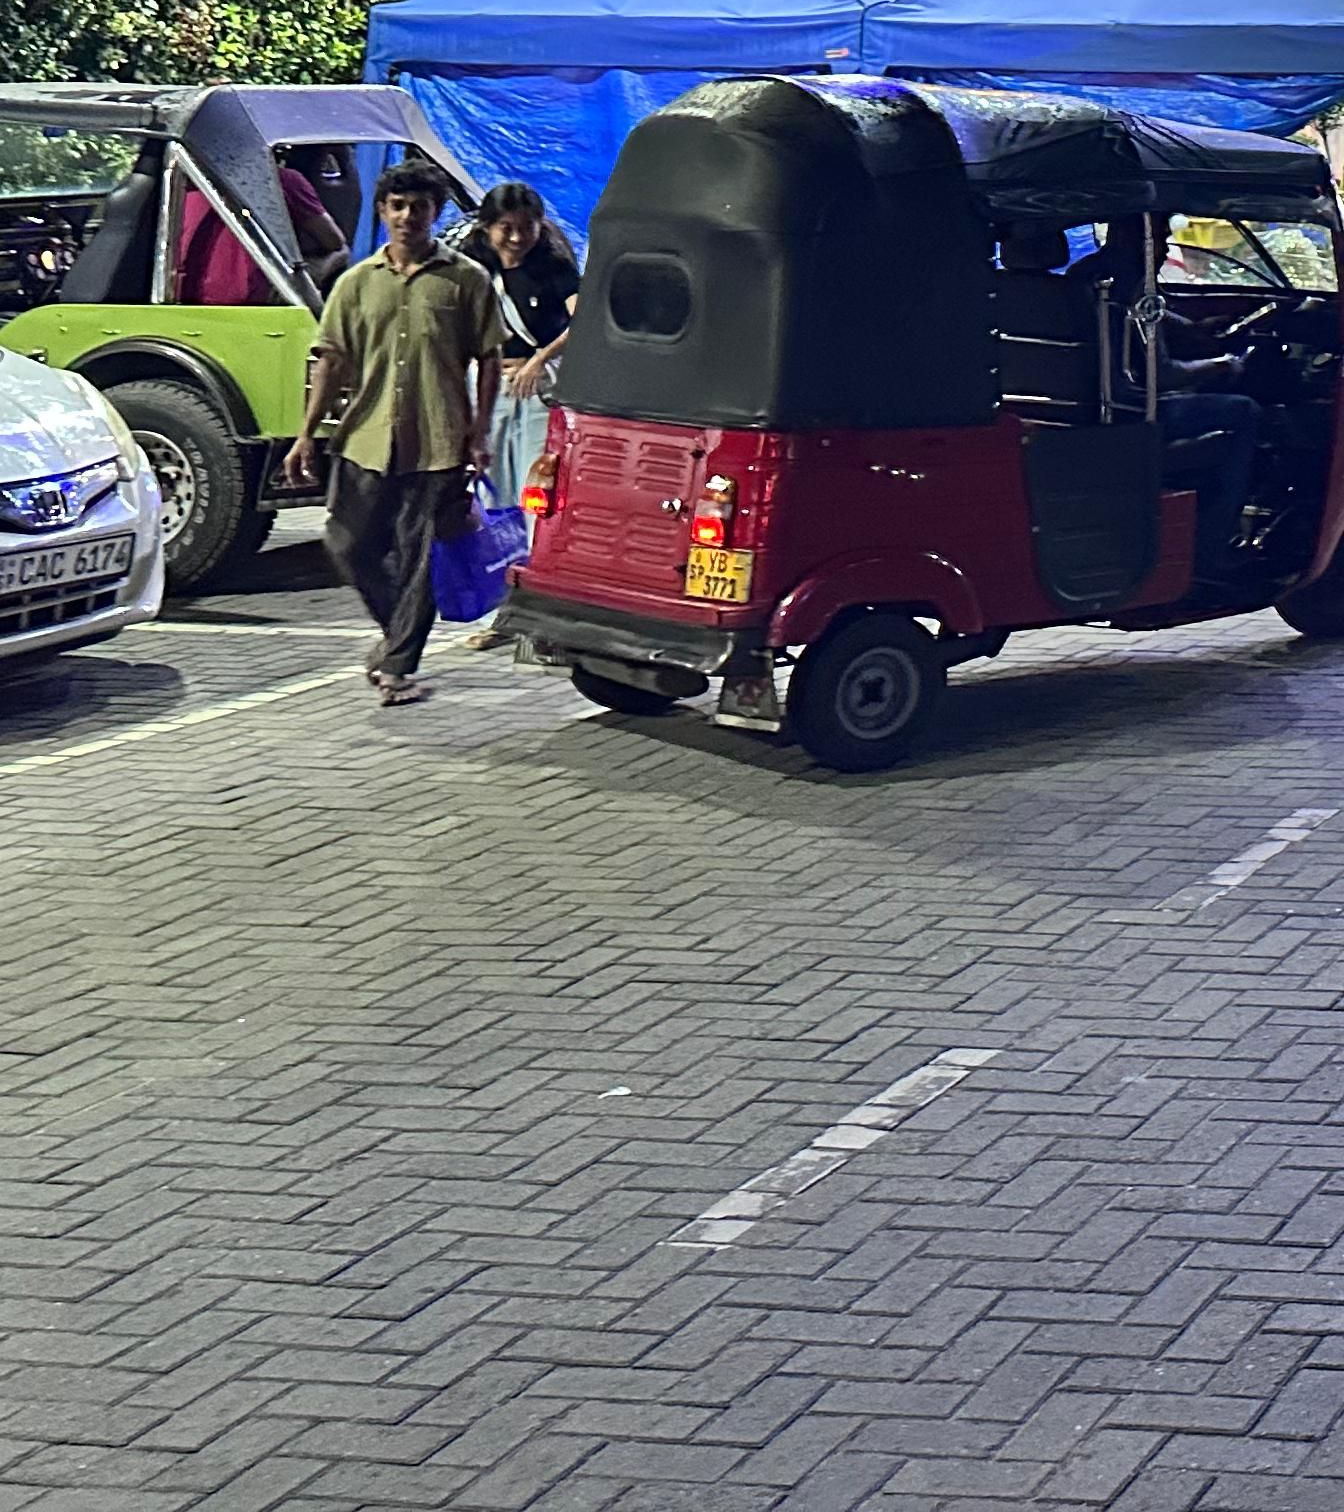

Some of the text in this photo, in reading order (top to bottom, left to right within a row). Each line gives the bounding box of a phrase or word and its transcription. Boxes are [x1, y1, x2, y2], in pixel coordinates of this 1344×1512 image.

[19, 552, 66, 585] CAC
[74, 541, 129, 576] 6174
[690, 563, 705, 579] SP
[709, 551, 728, 574] YB
[703, 575, 737, 599] 3771
